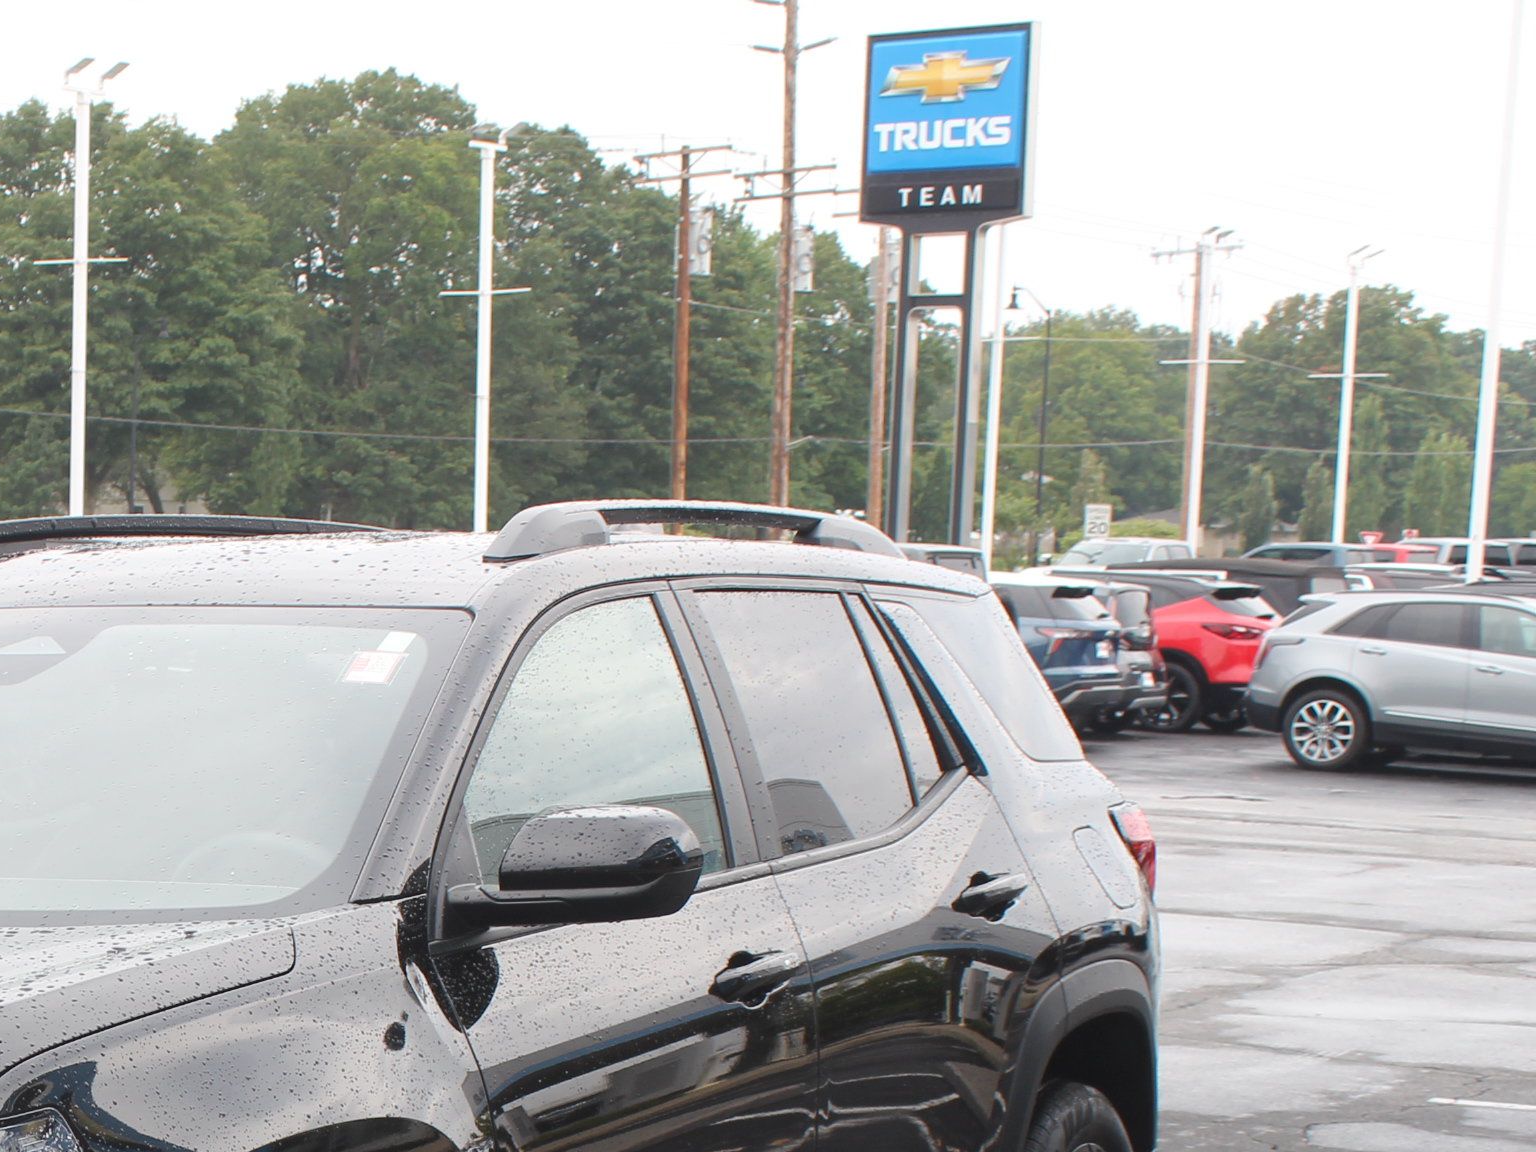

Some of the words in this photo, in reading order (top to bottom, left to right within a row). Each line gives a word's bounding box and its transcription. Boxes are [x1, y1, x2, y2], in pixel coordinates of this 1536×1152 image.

[873, 115, 1012, 152] TRUCKS
[897, 184, 983, 207] TEAM
[1087, 521, 1109, 535] 20
